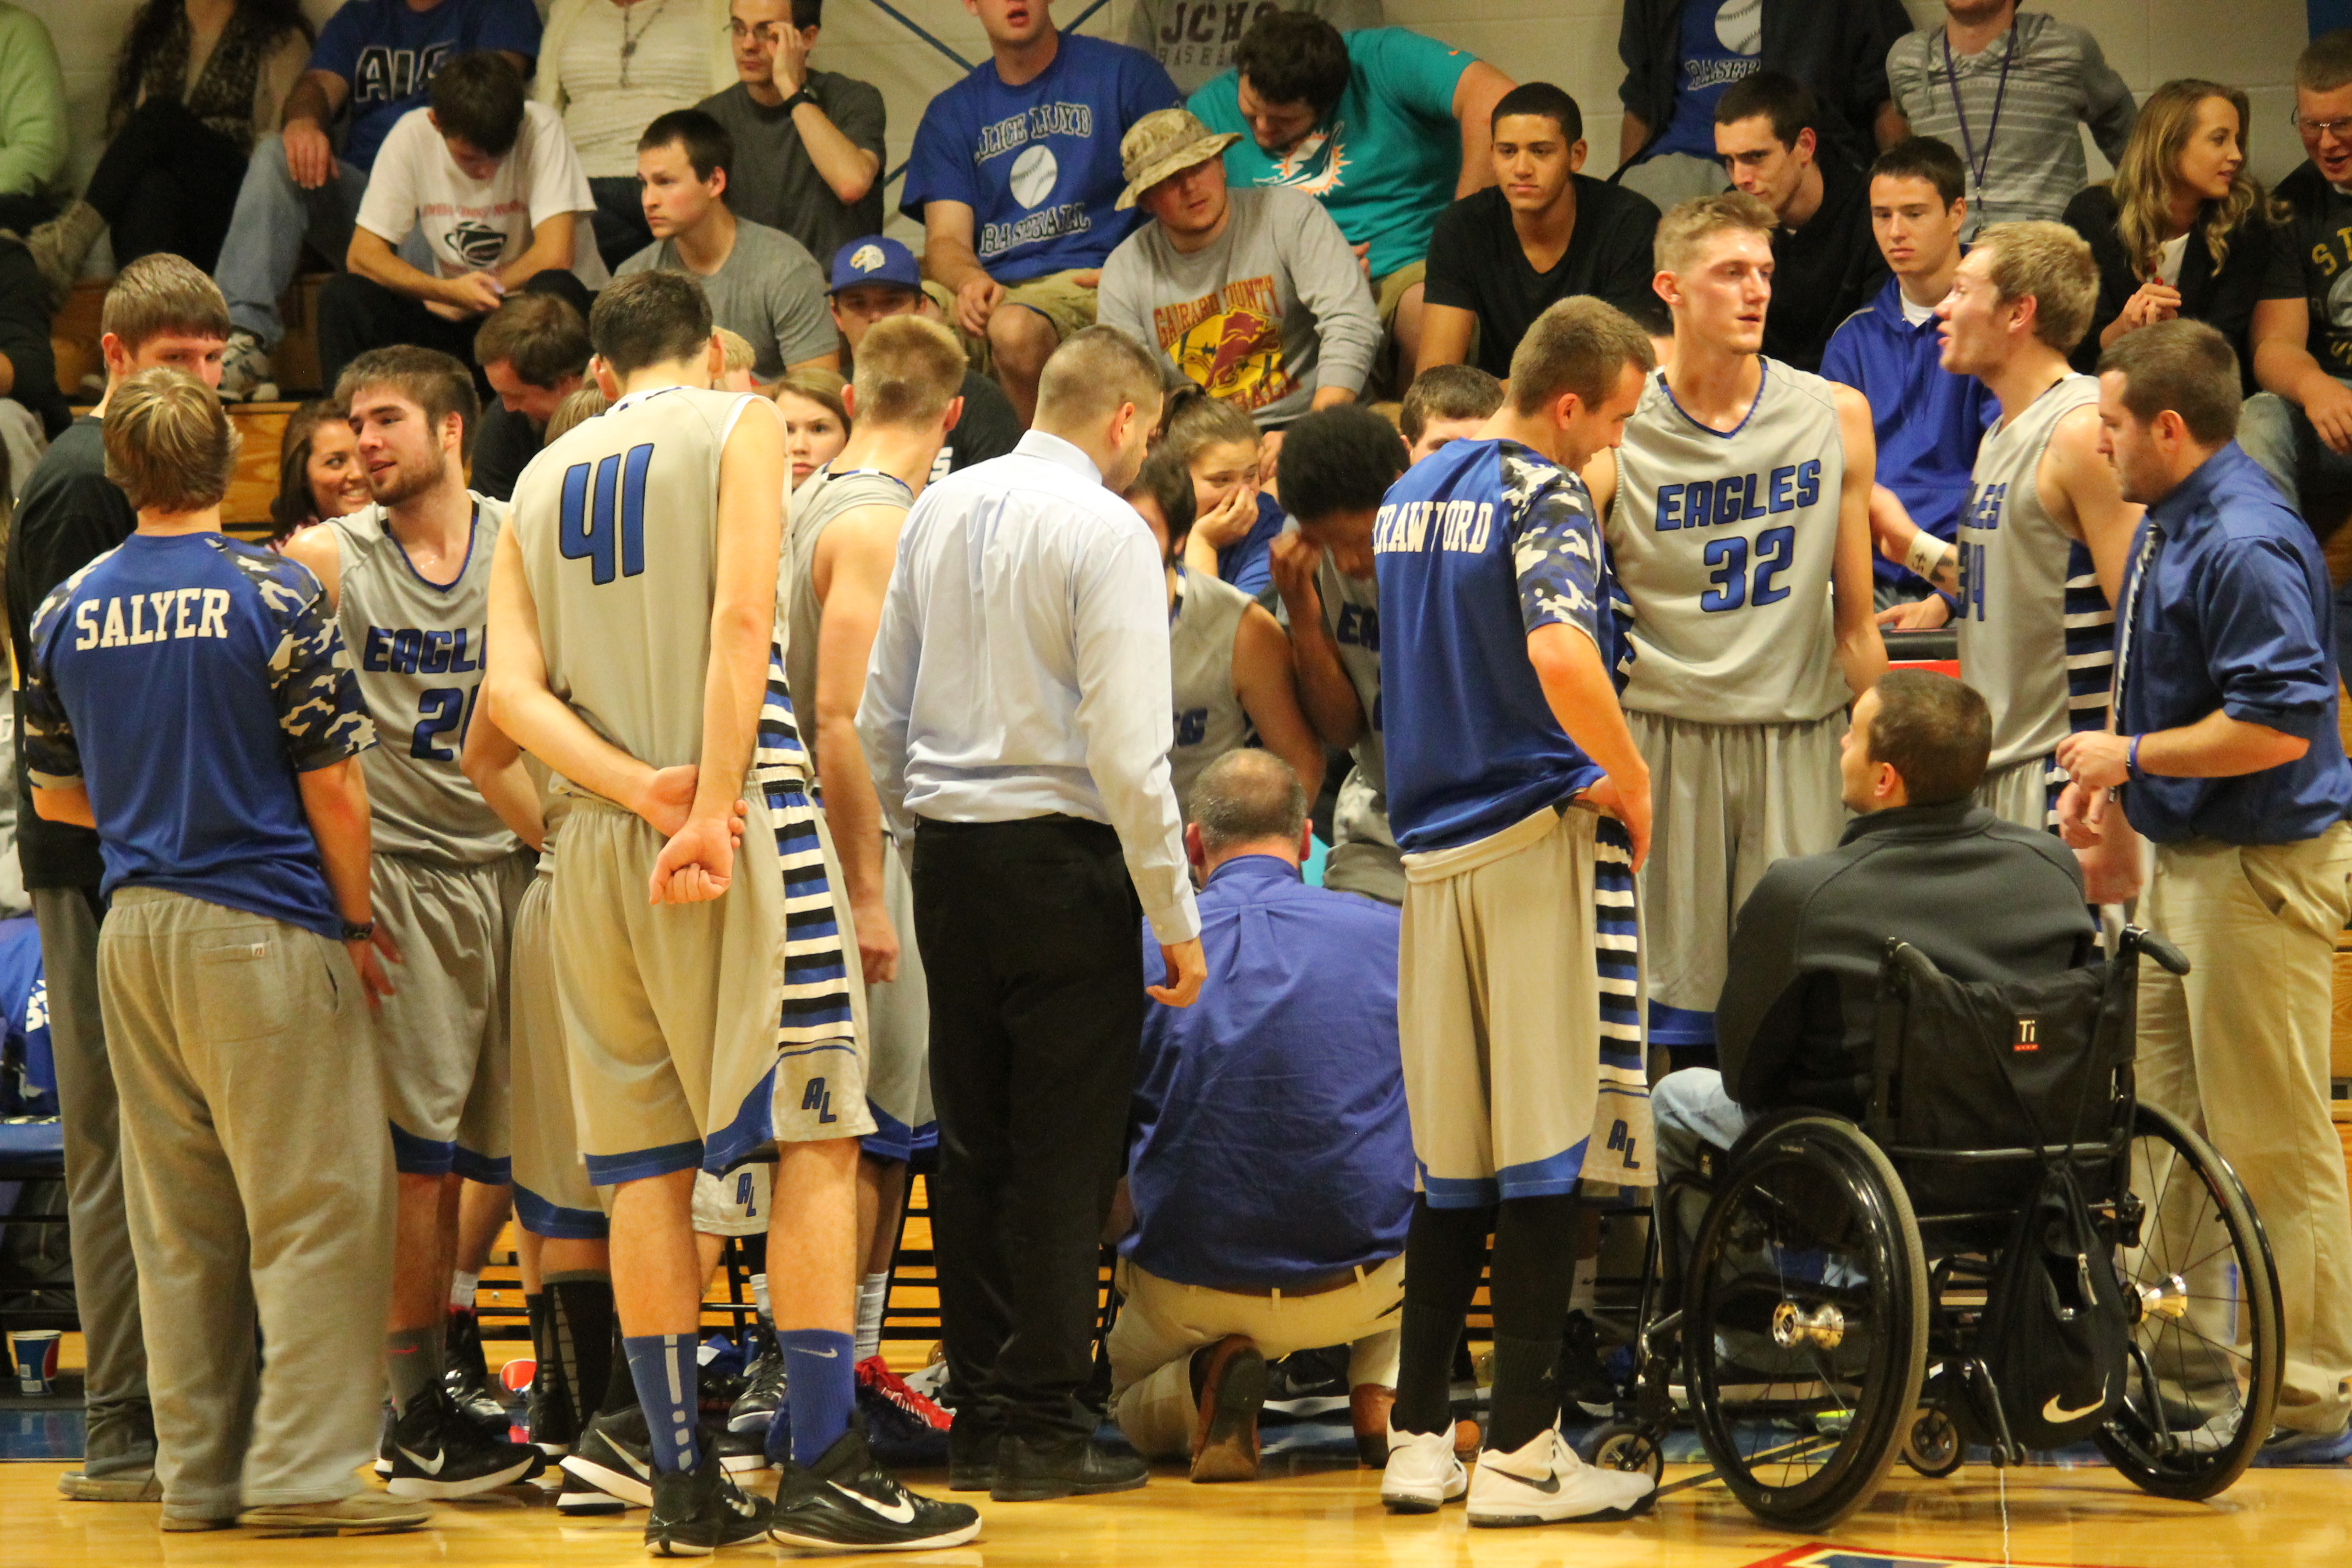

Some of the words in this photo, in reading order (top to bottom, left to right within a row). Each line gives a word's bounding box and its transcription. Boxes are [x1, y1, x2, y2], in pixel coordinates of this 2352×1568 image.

[559, 443, 655, 585] 41
[1655, 459, 1821, 531] EAGLES
[1701, 525, 1795, 612] 32
[75, 587, 230, 651] SALYER
[363, 624, 488, 674] EAGL
[410, 684, 480, 761] 2
[2019, 1020, 2035, 1042] Ti
[802, 1077, 837, 1123] AL
[1607, 1119, 1640, 1169] AL
